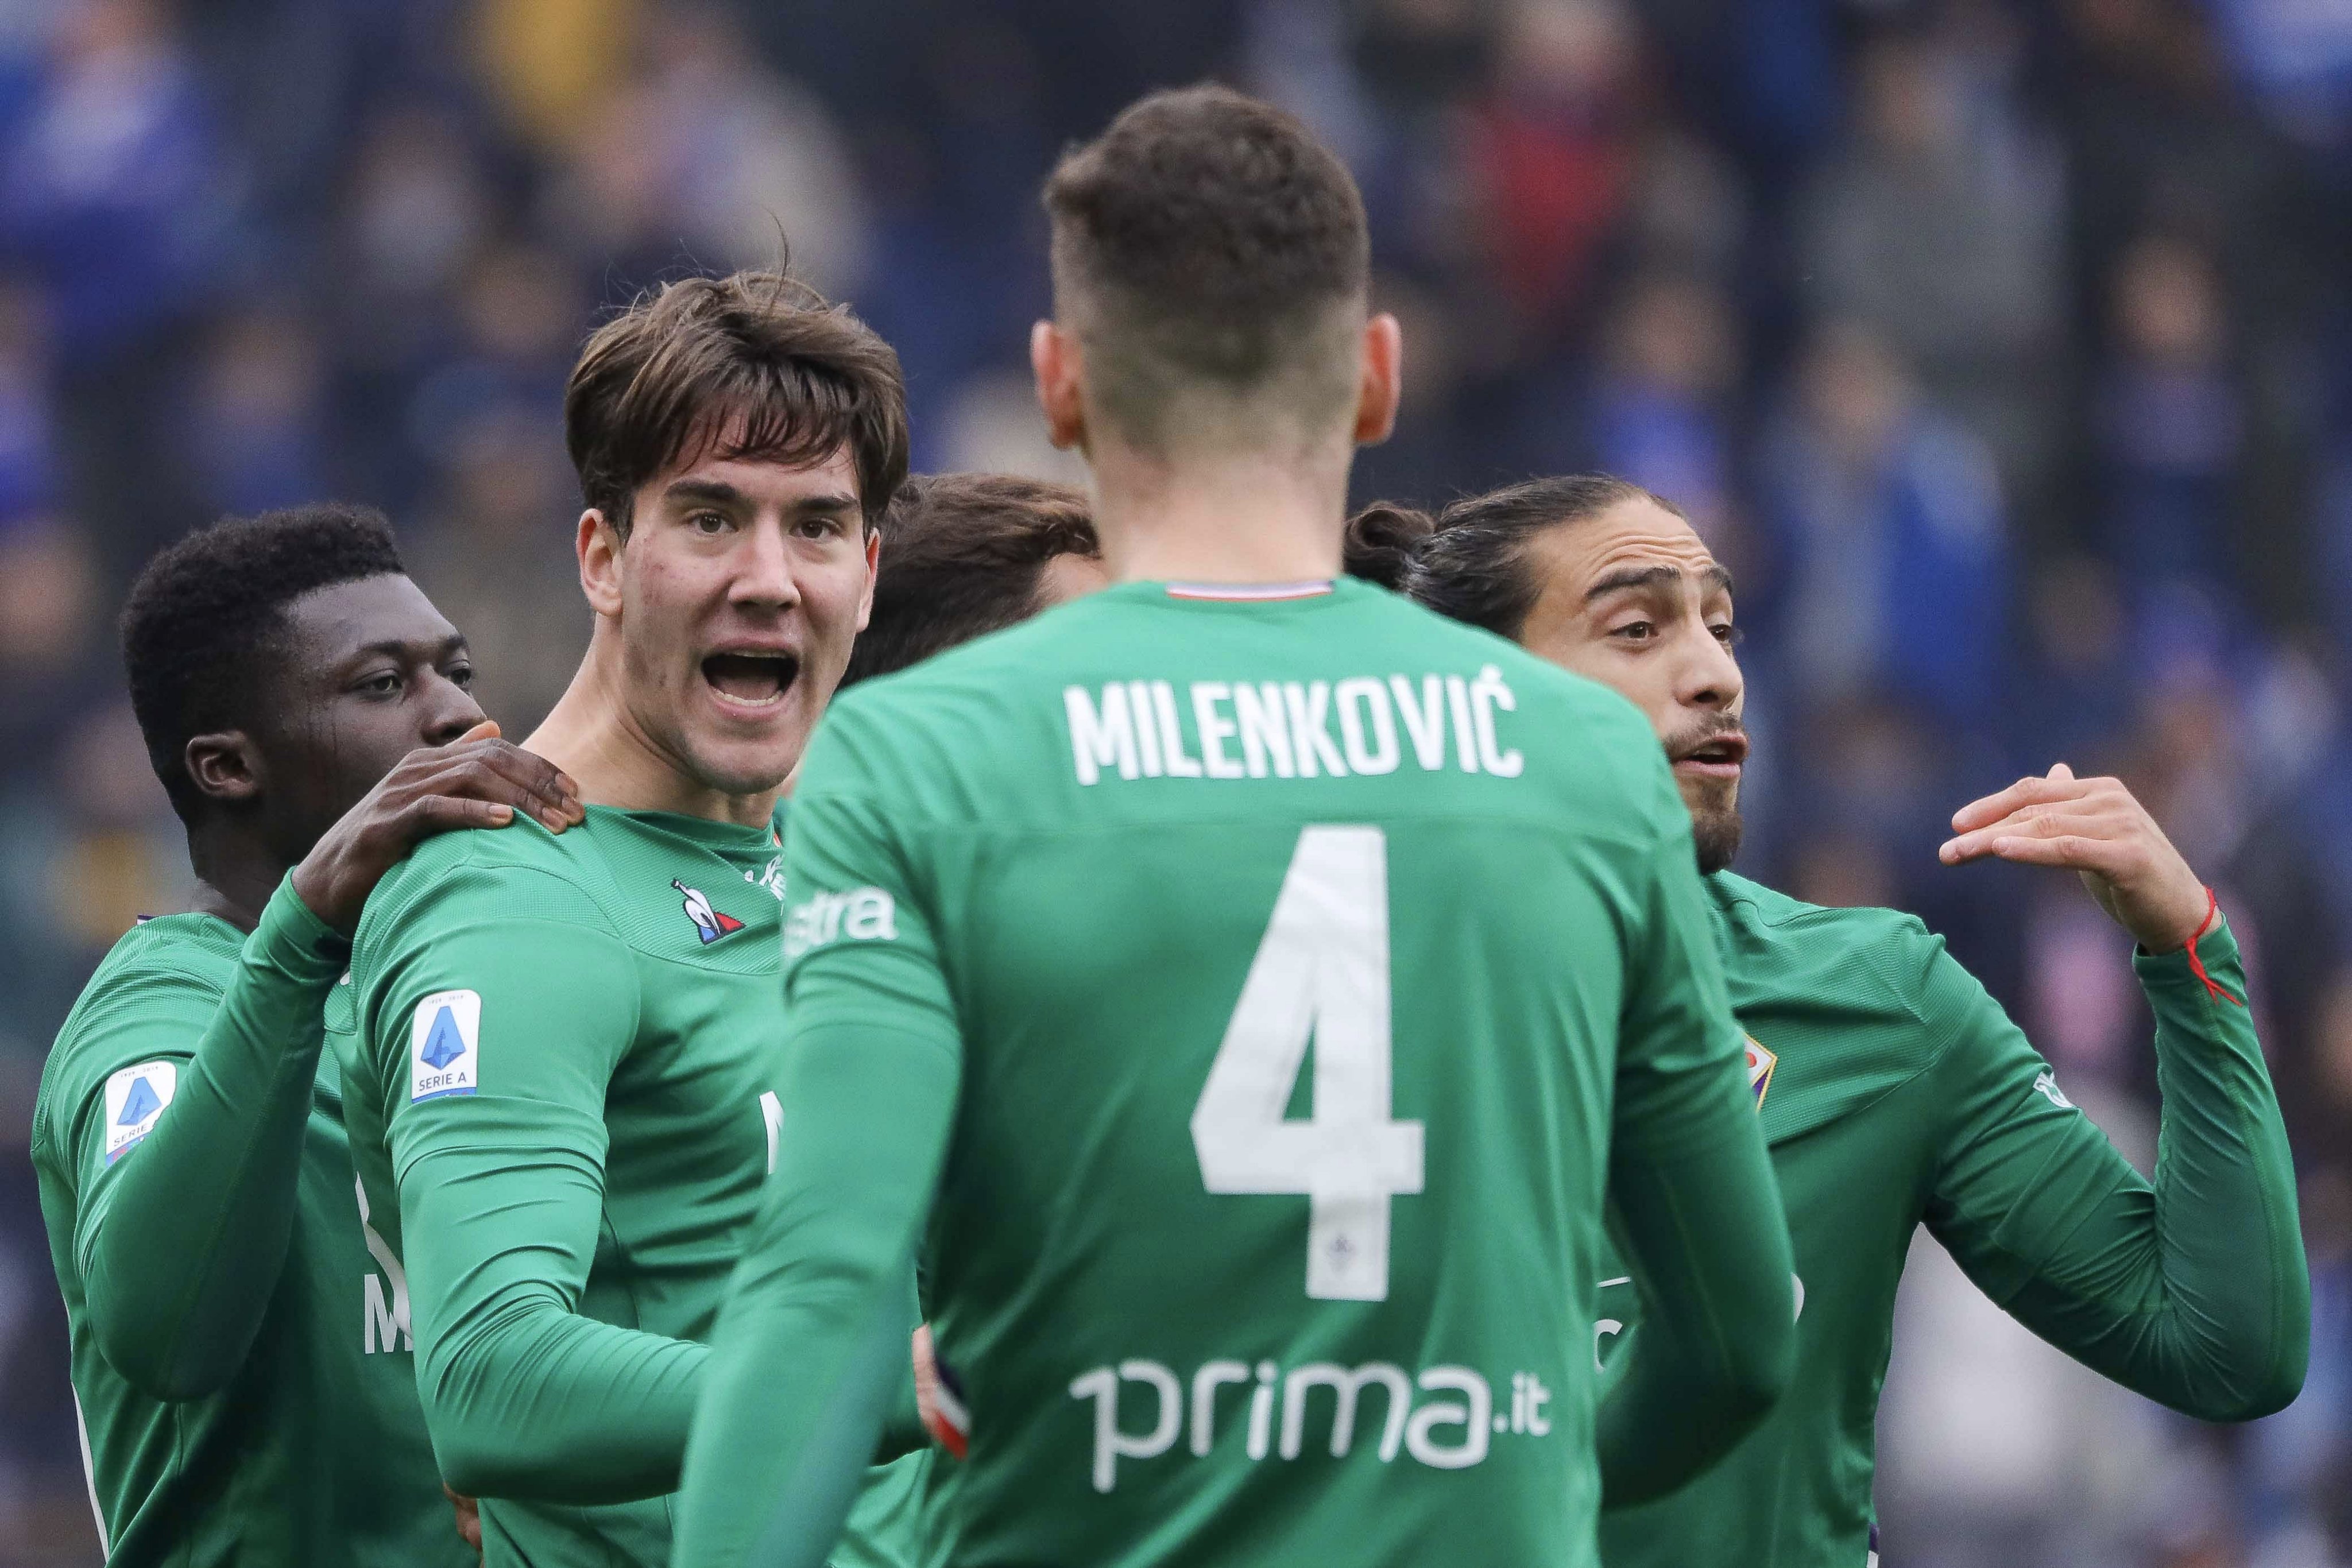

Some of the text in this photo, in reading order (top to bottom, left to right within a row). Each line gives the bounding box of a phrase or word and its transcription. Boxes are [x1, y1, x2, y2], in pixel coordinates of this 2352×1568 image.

[1062, 663, 1525, 787] MILENKOVIĆ
[418, 1071, 467, 1091] SERIE A
[1190, 823, 1425, 1302] 4
[114, 1123, 148, 1147] SERIE
[1068, 1356, 1552, 1493] prima.it
